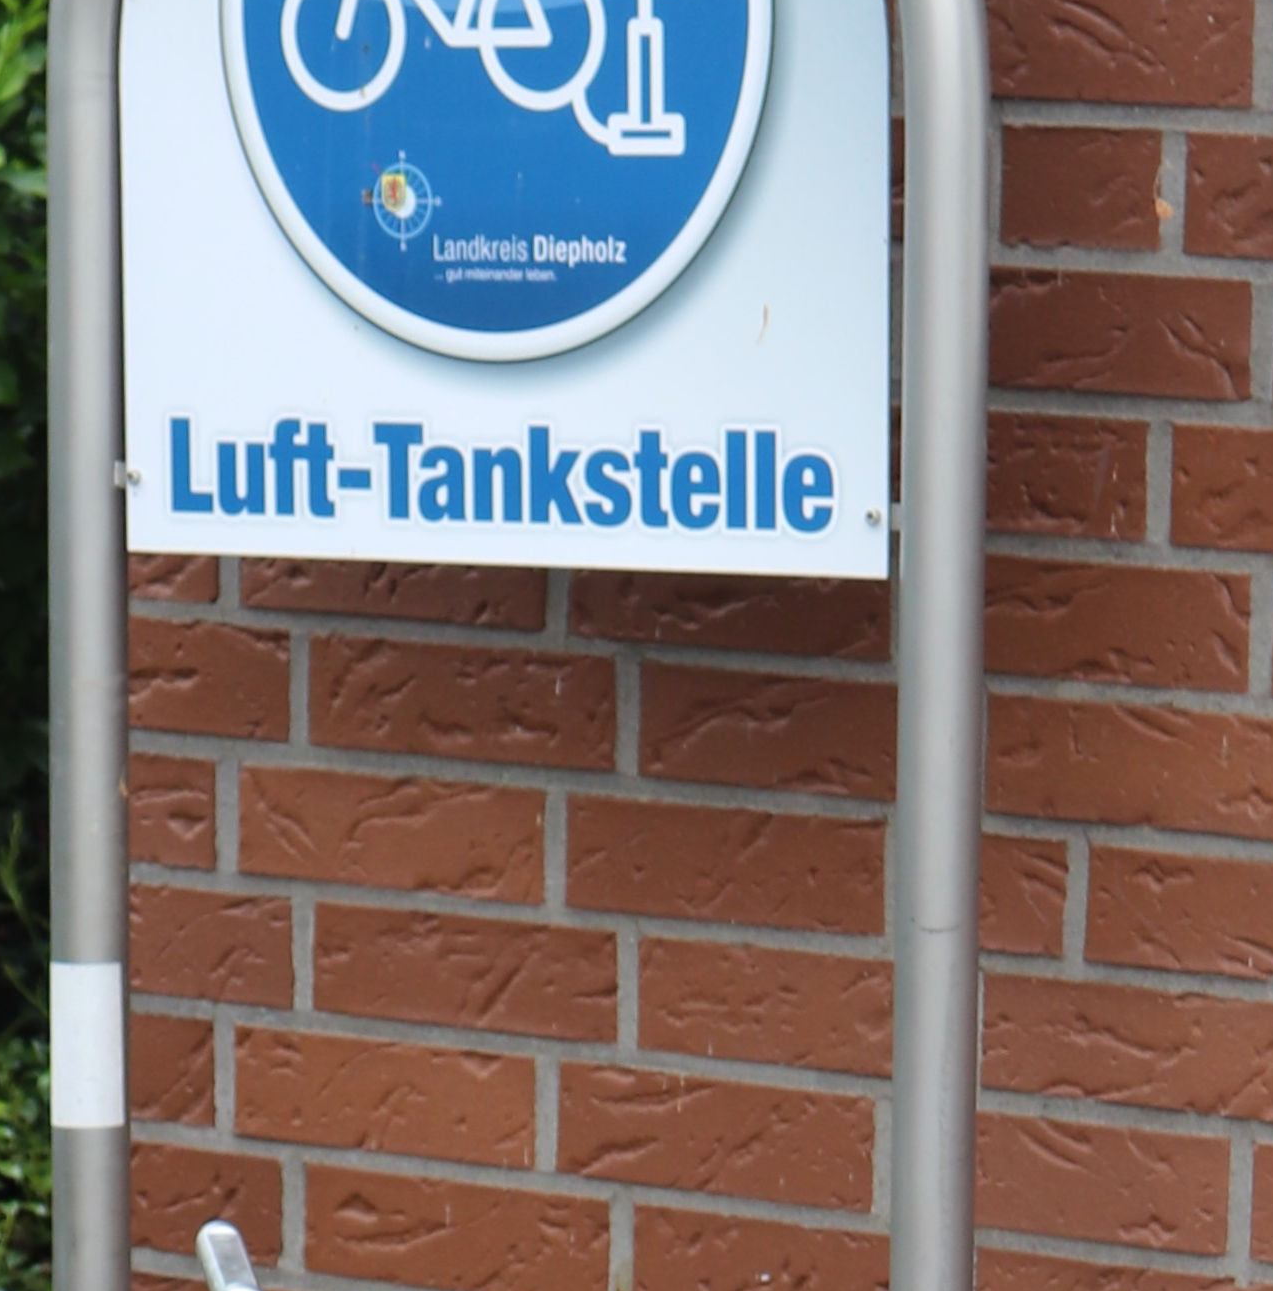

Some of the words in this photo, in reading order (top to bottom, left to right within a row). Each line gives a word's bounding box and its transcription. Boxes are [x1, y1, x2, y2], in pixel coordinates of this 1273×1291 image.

[433, 234, 528, 261] Landkreis
[533, 234, 627, 268] Diepholz
[446, 268, 463, 283] gut
[526, 268, 557, 281] leben.
[169, 417, 835, 533] Luft-Tankstelle
